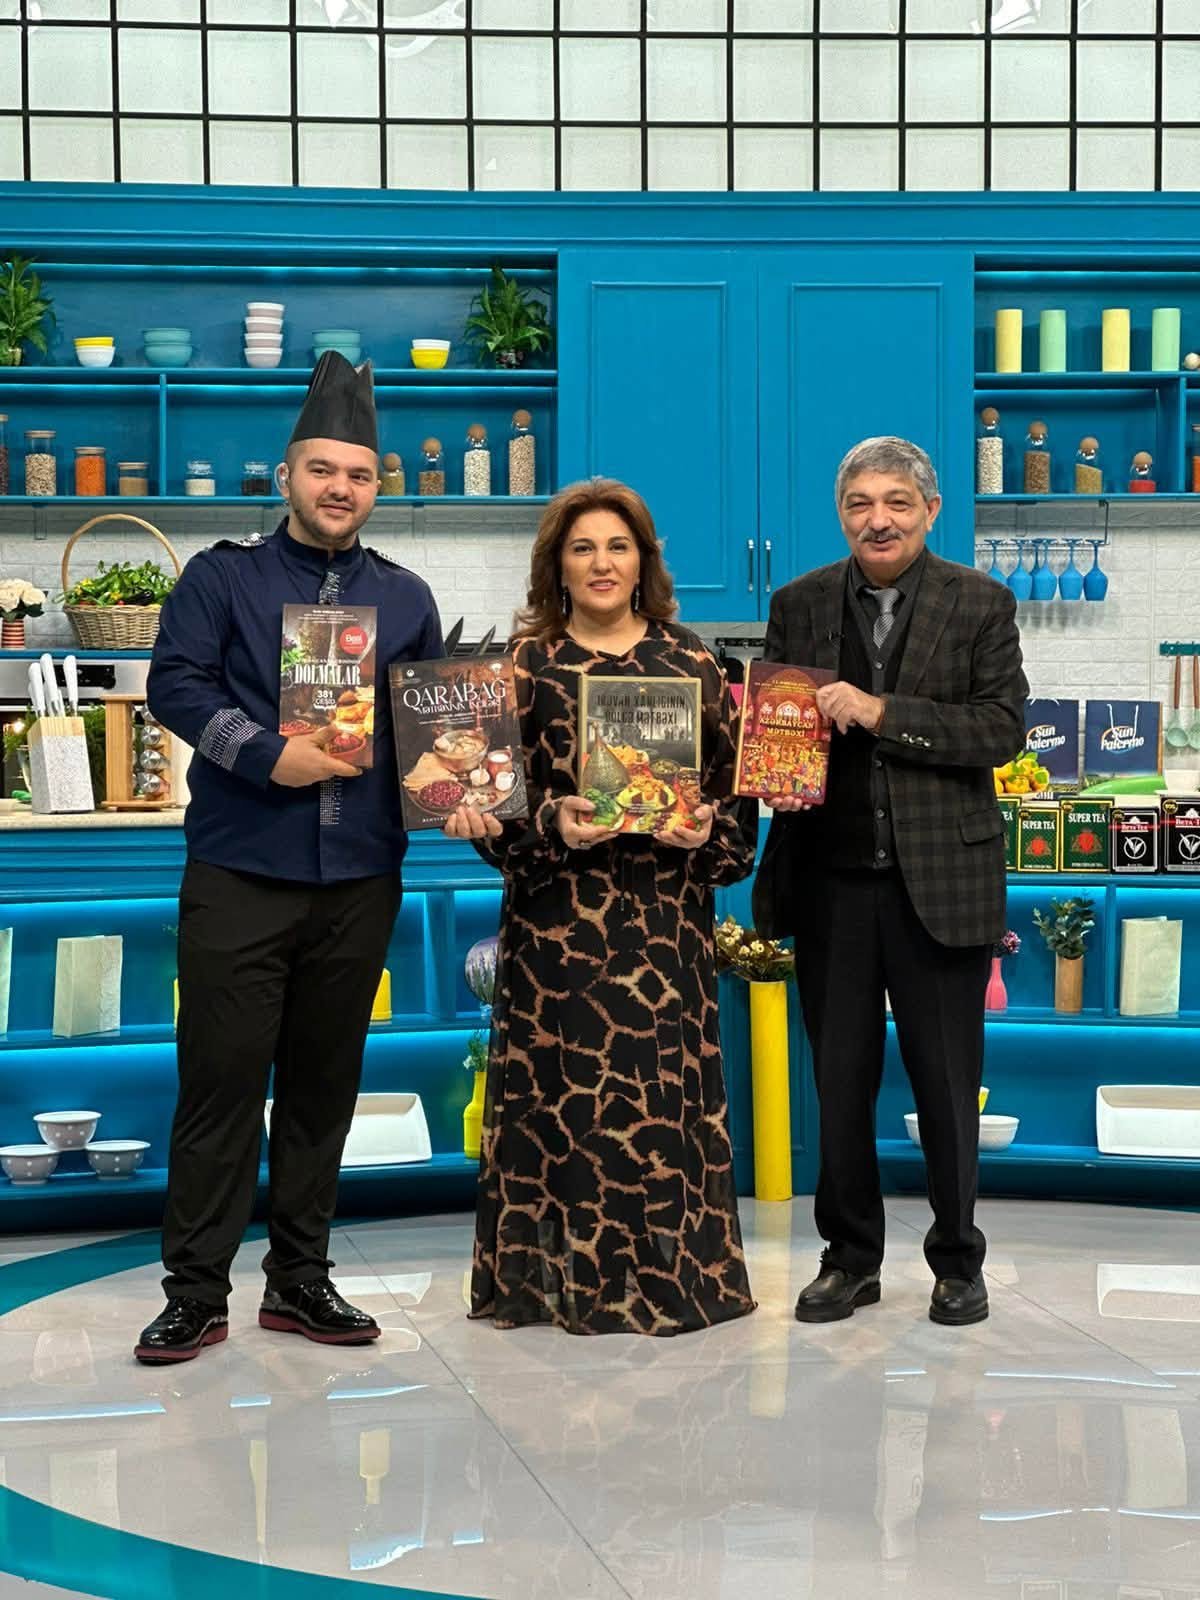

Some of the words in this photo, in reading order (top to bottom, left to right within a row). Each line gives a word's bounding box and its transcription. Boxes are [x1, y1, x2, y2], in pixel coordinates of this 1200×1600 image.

[294, 664, 361, 685] DOLMALAR
[317, 690, 333, 699] 381
[1034, 725, 1056, 739] Sun
[1110, 726, 1134, 740] Sun
[1026, 734, 1066, 750] Palermo
[1101, 735, 1145, 751] Palermo
[1022, 820, 1042, 830] SUPER
[1043, 820, 1055, 830] TEA
[1068, 813, 1091, 823] SUPER
[1092, 813, 1106, 823] TEA
